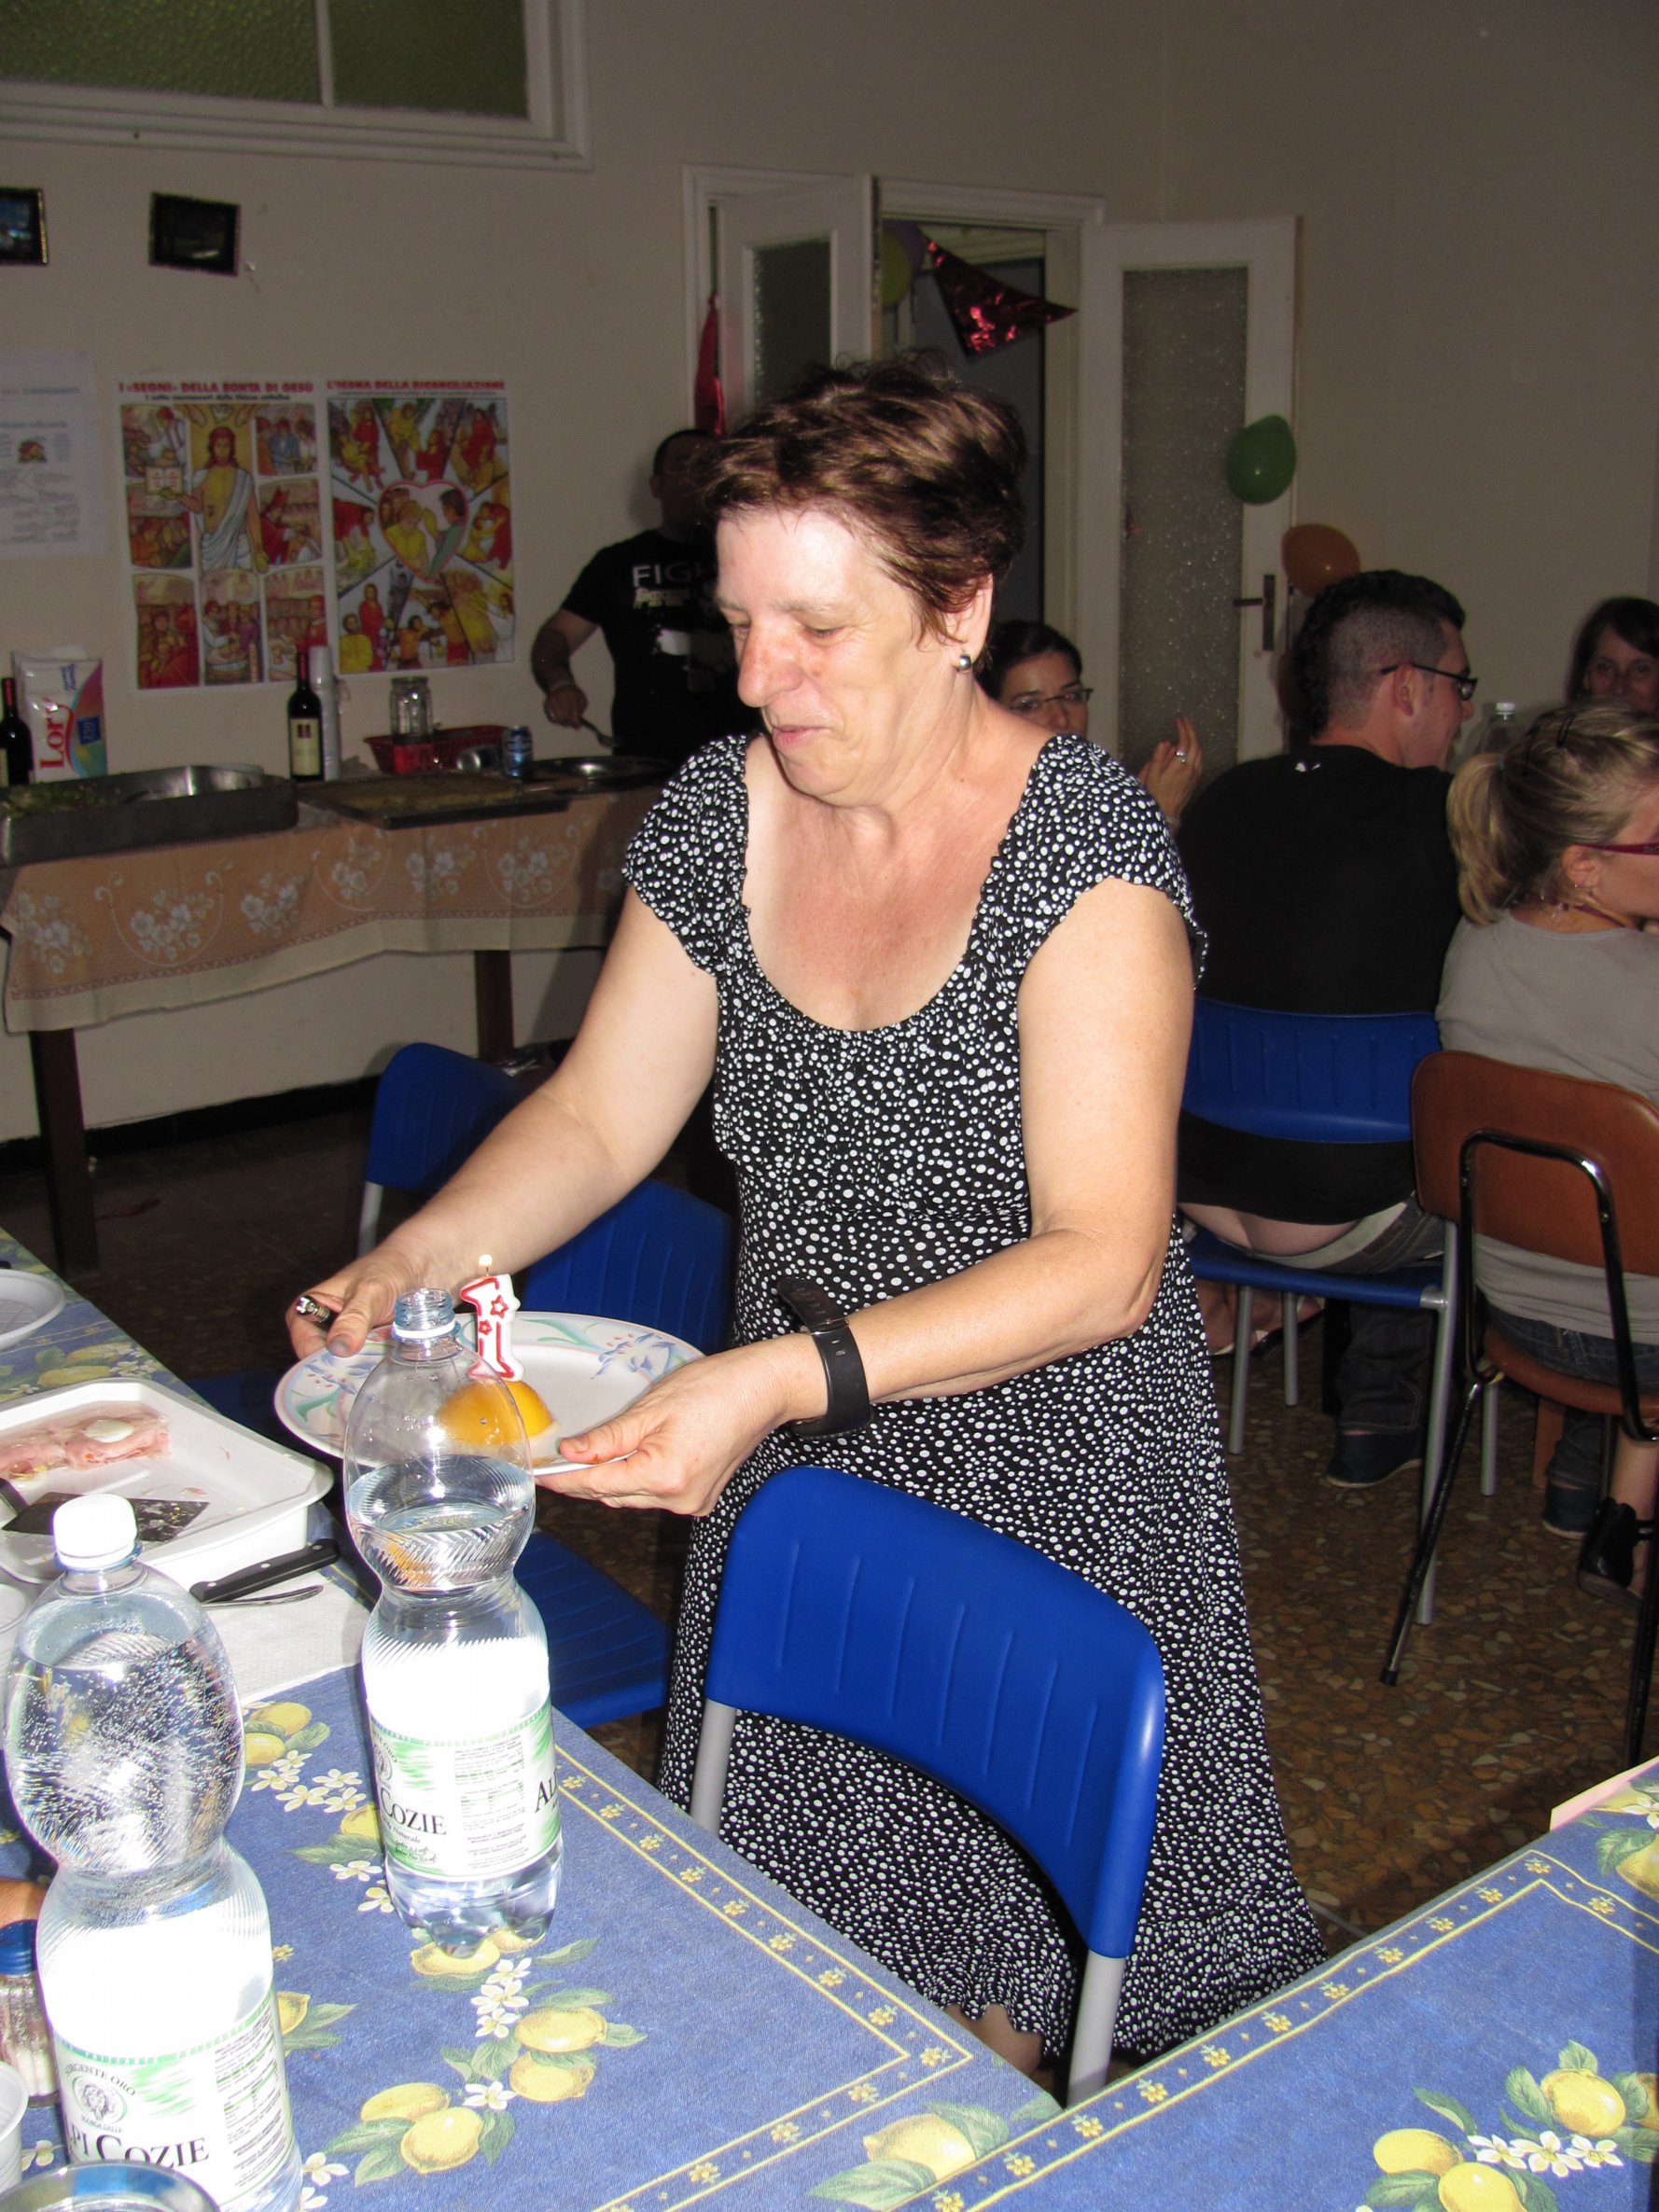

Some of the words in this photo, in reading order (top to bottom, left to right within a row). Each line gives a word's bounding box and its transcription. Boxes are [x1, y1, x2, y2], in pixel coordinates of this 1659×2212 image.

[181, 382, 219, 393] DELLA
[264, 382, 279, 393] DI
[374, 381, 410, 390] DELLA
[380, 1787, 447, 1836] COZIE
[109, 2076, 137, 2097] ORO
[96, 2134, 210, 2169] COZIE
